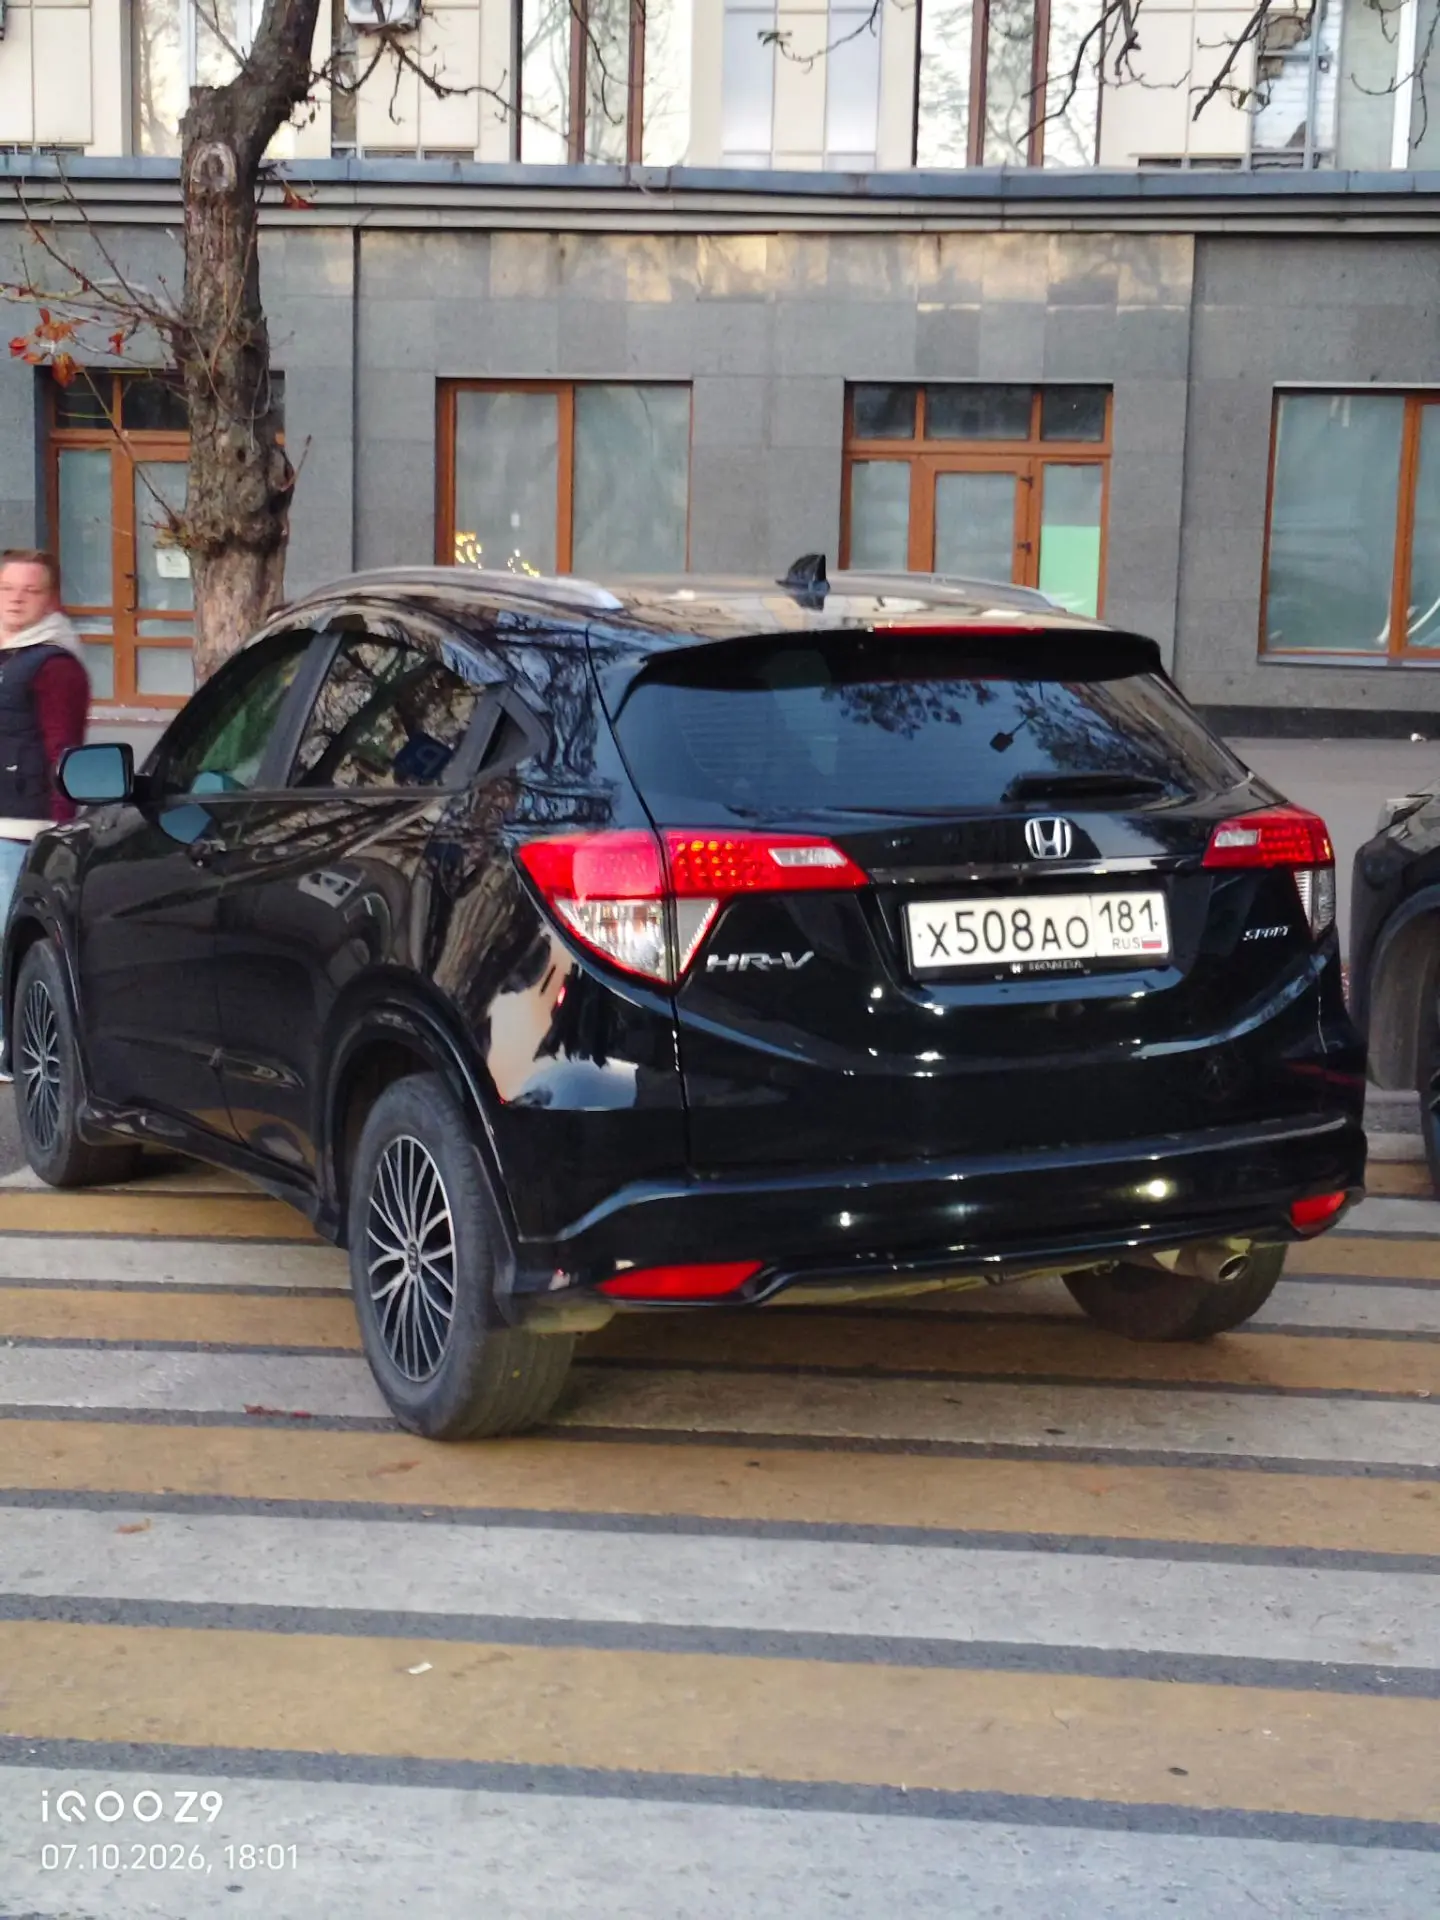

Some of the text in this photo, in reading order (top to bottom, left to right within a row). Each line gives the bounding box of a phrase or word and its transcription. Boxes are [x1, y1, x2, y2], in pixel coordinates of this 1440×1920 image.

[926, 899, 1157, 958] Х508АО 181
[1112, 936, 1141, 950] RUS
[705, 950, 815, 972] HR-V
